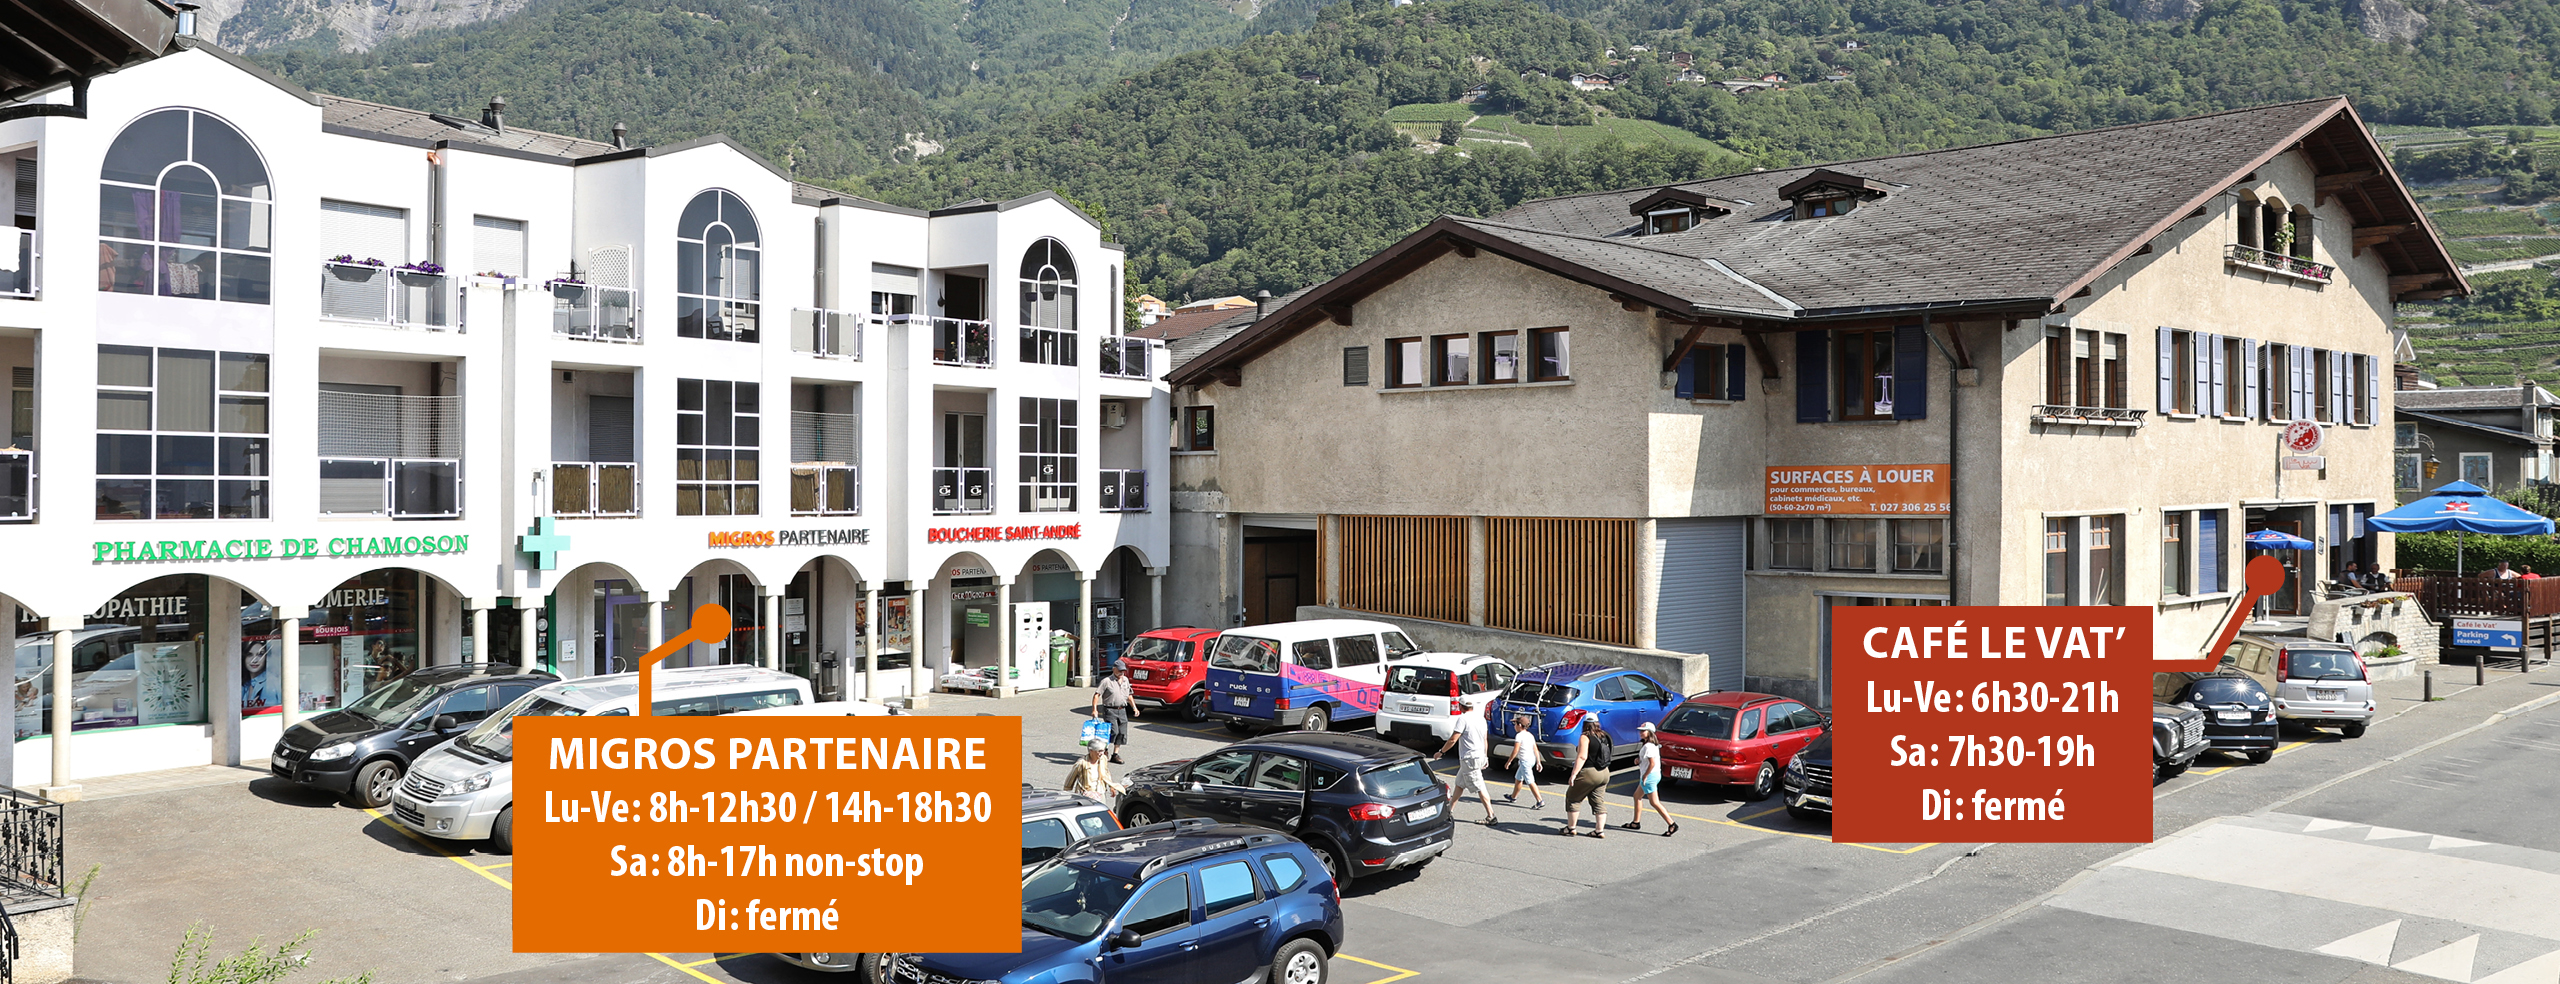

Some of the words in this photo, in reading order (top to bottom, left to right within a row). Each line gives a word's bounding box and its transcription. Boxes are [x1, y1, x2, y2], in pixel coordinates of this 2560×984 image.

[1770, 470, 1854, 484] SURFACES
[1859, 466, 1872, 483] À
[1877, 469, 1934, 484] LOUER
[1839, 486, 1876, 494] bureaux,
[1804, 494, 1845, 502] médicaux,
[1769, 504, 1815, 512] (50-60-2x70
[1870, 503, 1878, 512] T.
[1880, 503, 1898, 512] 027
[1901, 503, 1920, 512] 306
[1923, 503, 1936, 512] 25
[1939, 503, 1951, 512] 56
[928, 526, 1003, 544] BOUCHERIE
[1005, 521, 1082, 542] SAINT-ANDRÉ
[708, 529, 775, 547] MIGROS
[778, 528, 870, 546] PARTENAIRE
[94, 539, 273, 562] PHARMACIE
[282, 537, 319, 557] DE
[328, 534, 470, 556] CHAMOSON
[962, 567, 987, 576] PARTEN
[315, 625, 349, 634] BOURJOIS
[2456, 630, 2489, 640] Parking
[1229, 683, 1248, 691] ruck
[1201, 839, 1242, 852] DUSTER
